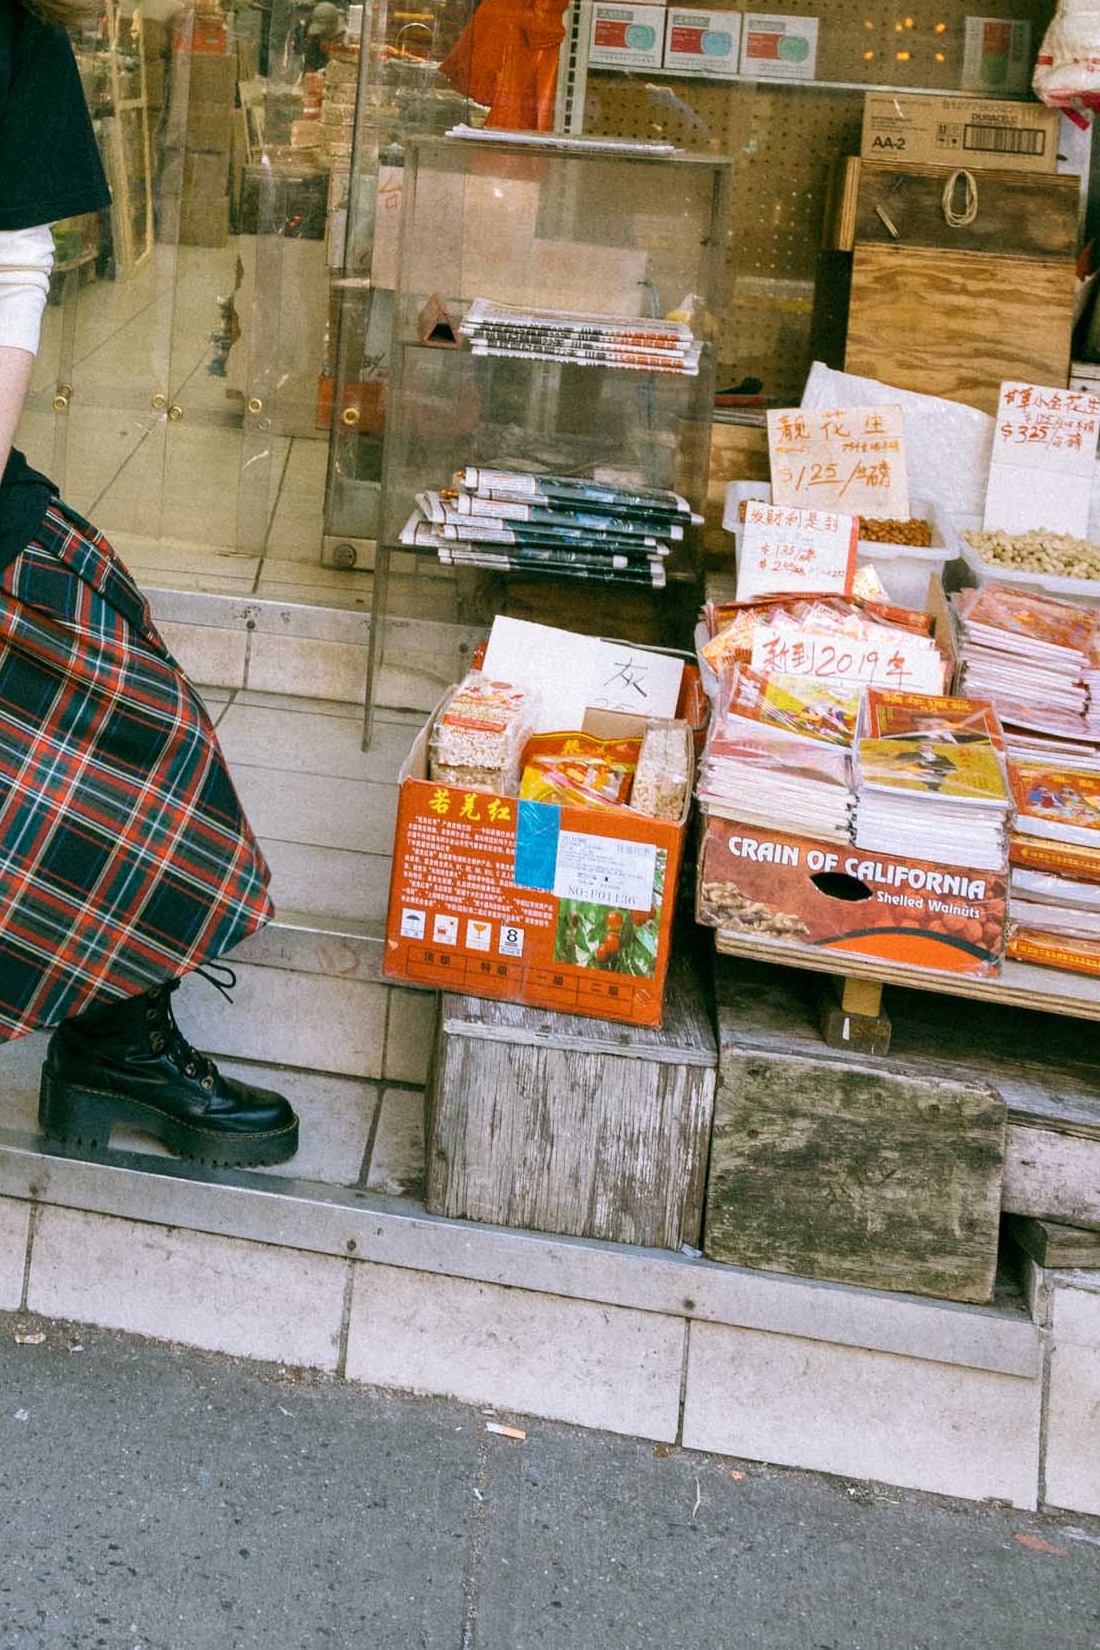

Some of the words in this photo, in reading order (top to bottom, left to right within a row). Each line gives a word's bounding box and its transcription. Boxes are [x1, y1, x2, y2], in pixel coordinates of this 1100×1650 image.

[872, 135, 907, 151] AA-2
[728, 835, 800, 867] CRAIN
[806, 850, 839, 873] OF
[844, 857, 987, 901] CALIFORNIA
[876, 890, 924, 910] Shelled
[928, 899, 981, 919] Walnuts
[506, 928, 519, 943] 8
